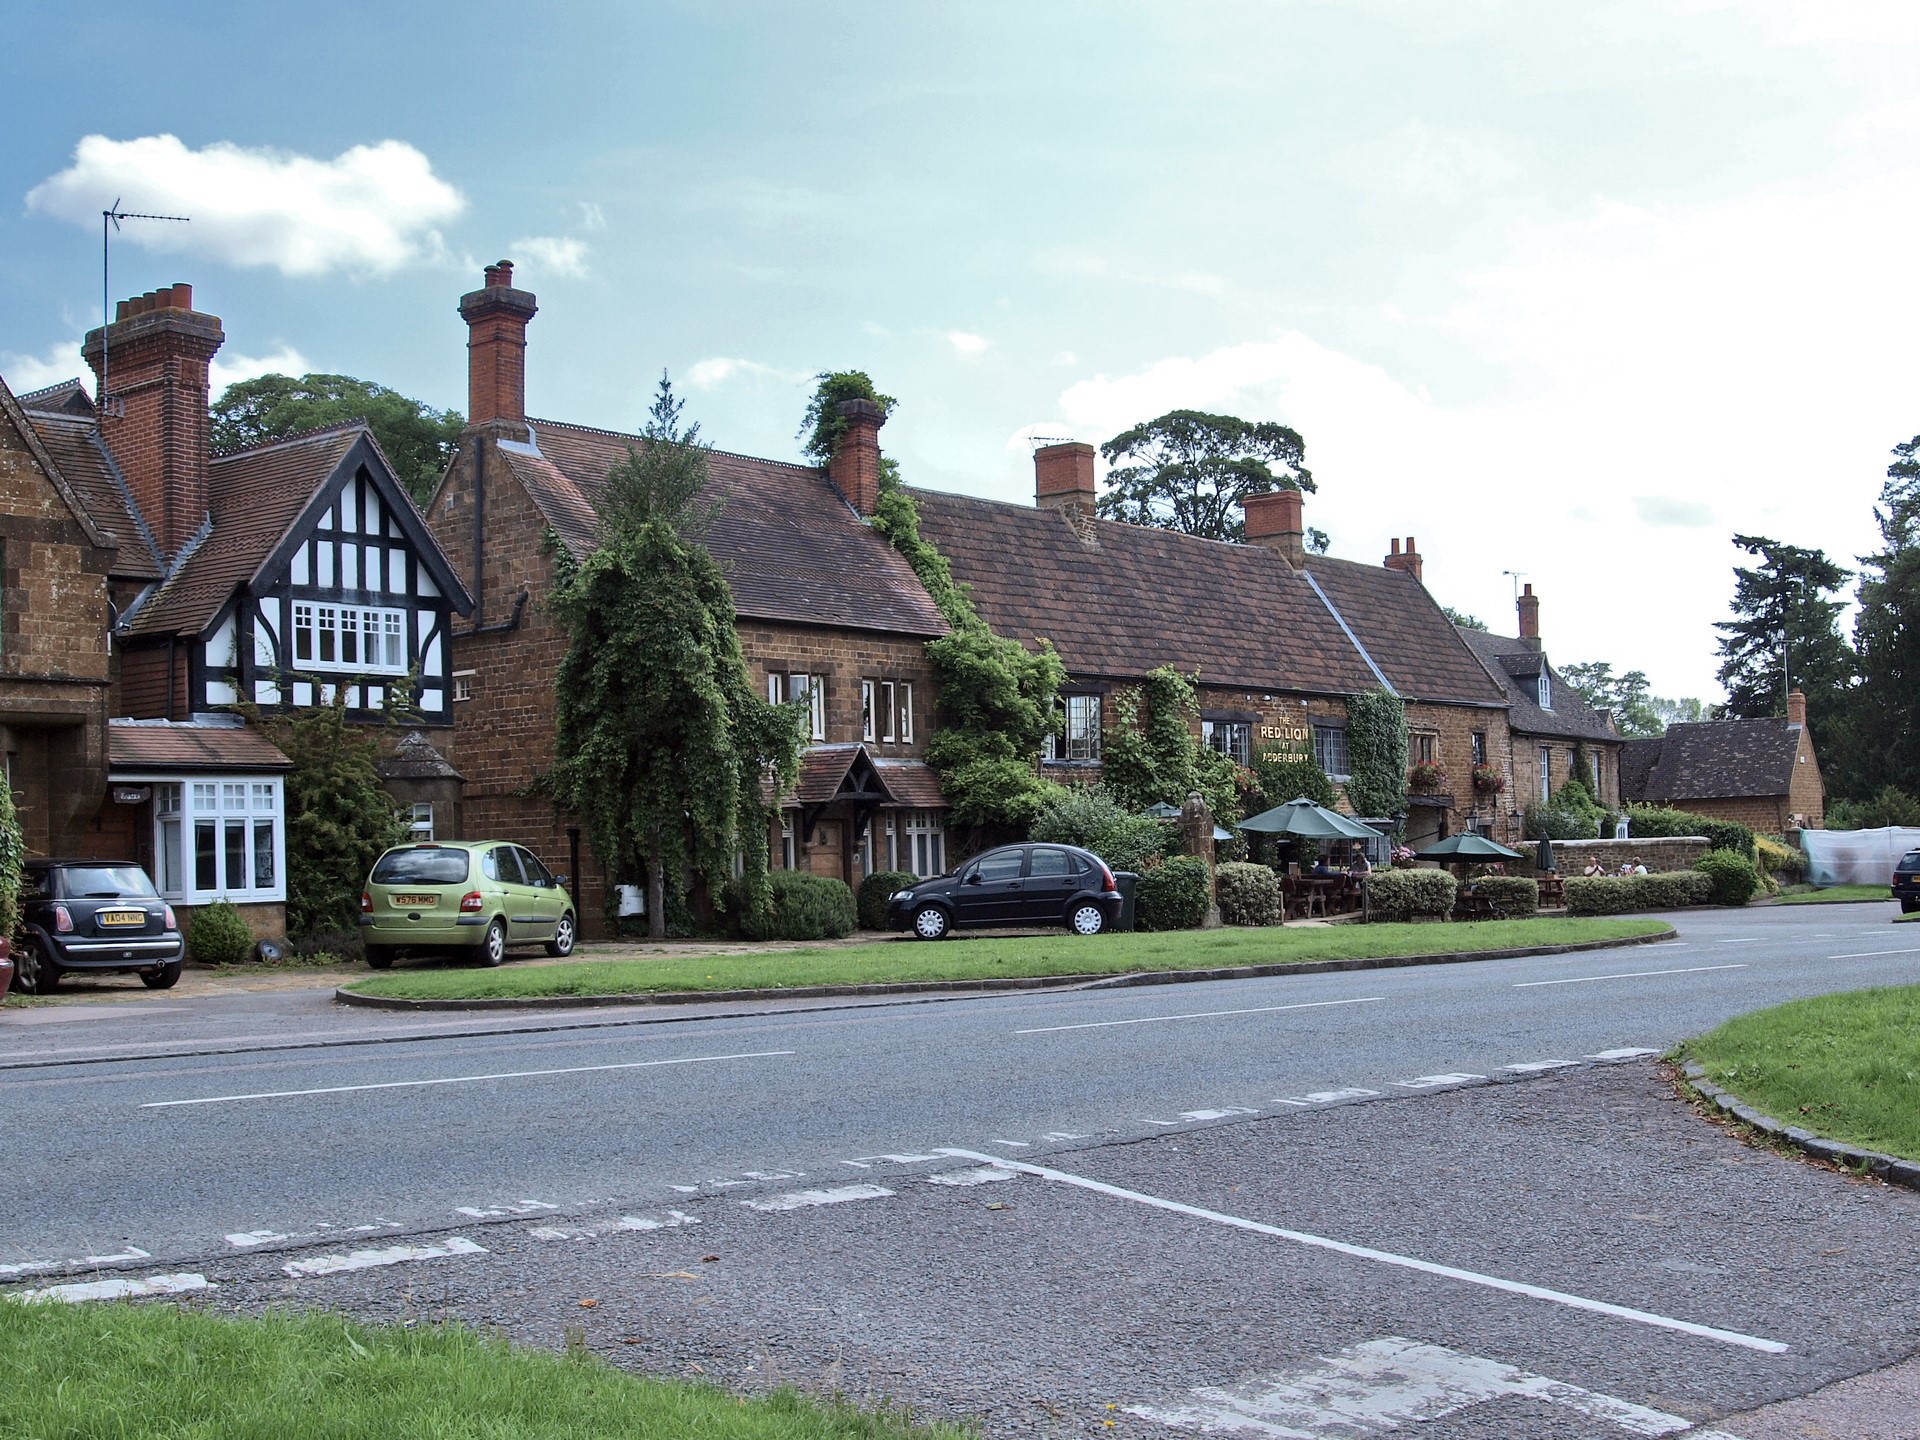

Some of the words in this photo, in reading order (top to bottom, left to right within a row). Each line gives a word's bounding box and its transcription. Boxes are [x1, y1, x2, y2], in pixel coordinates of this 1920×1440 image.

[1279, 716, 1290, 725] THE
[1261, 726, 1281, 739] RED
[1285, 727, 1309, 741] LION
[1281, 742, 1290, 750] AT
[1262, 752, 1309, 763] ADDERBURY
[396, 895, 417, 904] W576
[104, 914, 126, 923] VA04
